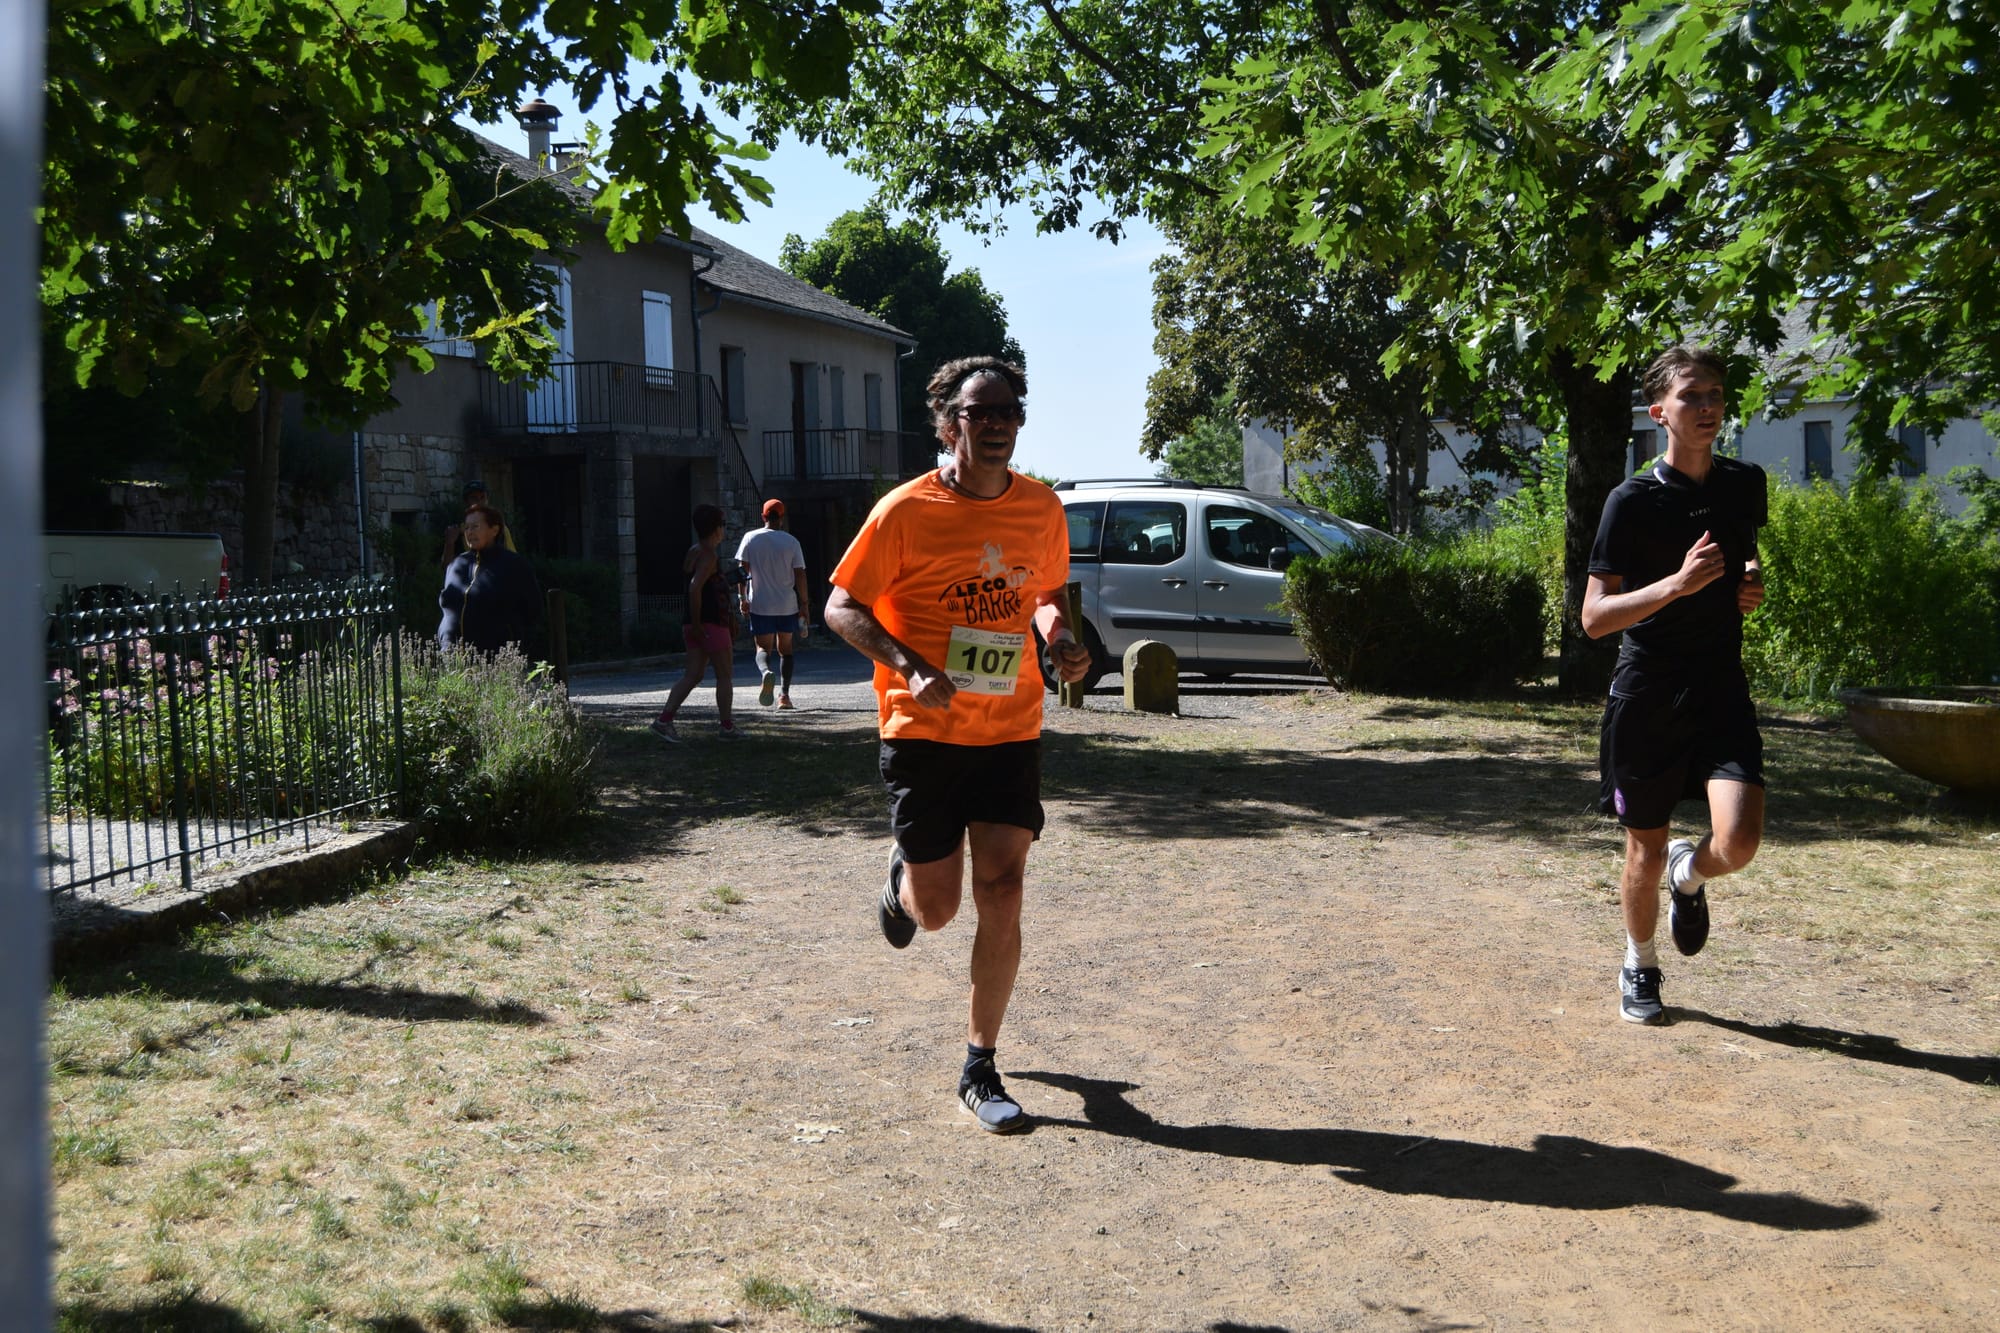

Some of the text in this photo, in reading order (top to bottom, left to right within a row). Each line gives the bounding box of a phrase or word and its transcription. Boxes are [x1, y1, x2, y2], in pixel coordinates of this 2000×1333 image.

[956, 582, 978, 597] LE
[964, 587, 1021, 624] BARRE
[961, 646, 1015, 674] 107
